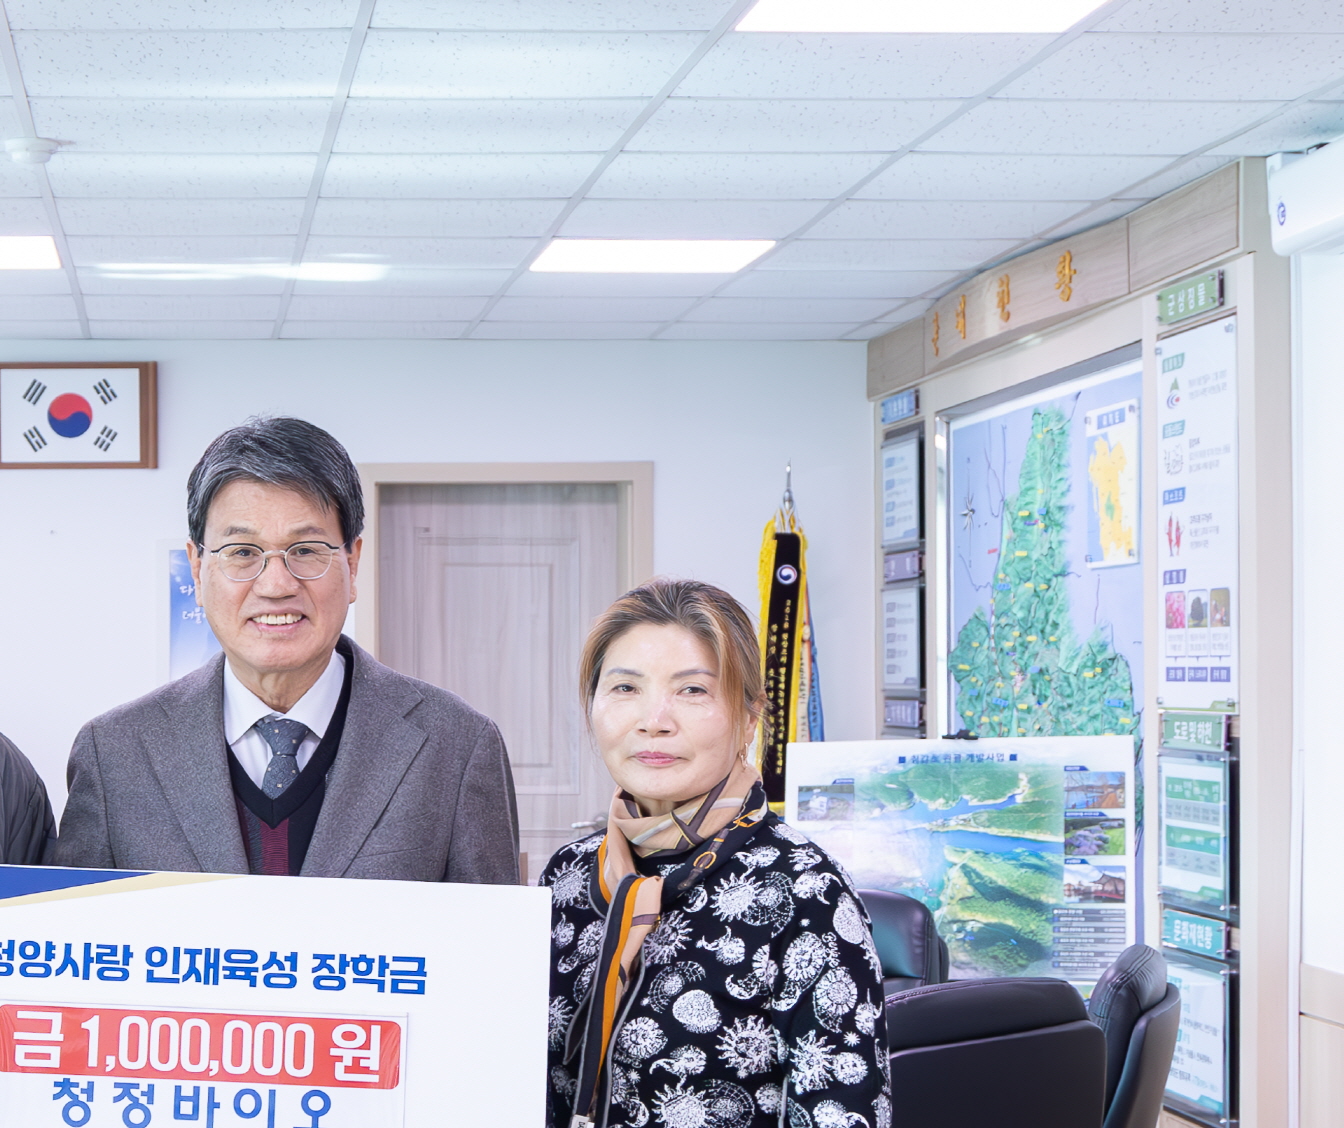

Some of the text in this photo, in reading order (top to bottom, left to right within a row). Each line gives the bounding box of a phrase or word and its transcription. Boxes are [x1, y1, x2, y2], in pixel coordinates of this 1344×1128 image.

[179, 584, 196, 596] 다
[1173, 919, 1213, 950] 문화재현황
[144, 945, 299, 989] 인재육성
[311, 953, 428, 996] 장학금
[13, 1010, 381, 1083] 금 1,000,000 원
